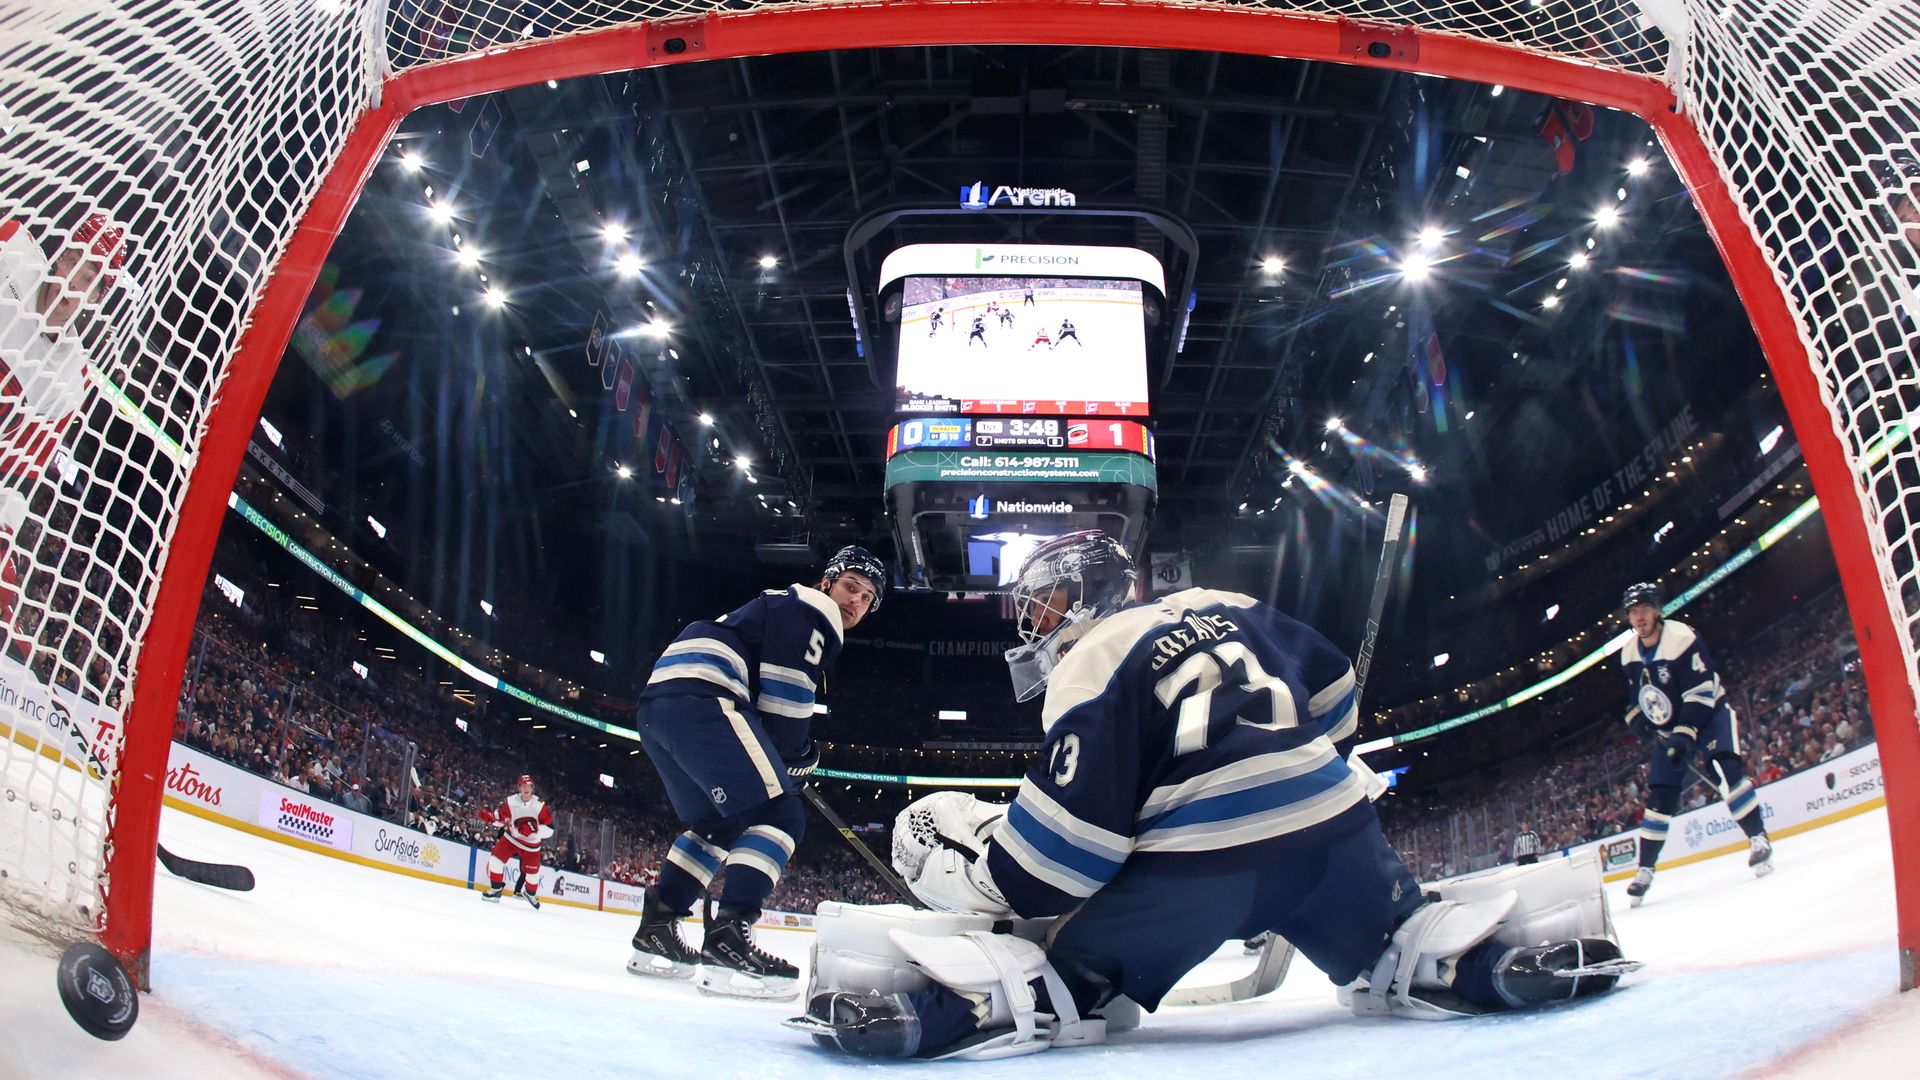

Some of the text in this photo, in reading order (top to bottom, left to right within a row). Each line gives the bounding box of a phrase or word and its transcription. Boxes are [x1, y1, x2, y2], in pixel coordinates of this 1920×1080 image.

[989, 186, 1076, 206] Arena
[1001, 255, 1079, 264] PRECISION
[904, 421, 923, 445] 0
[1108, 423, 1123, 446] 1
[940, 468, 1099, 478] precisionconstructionsystems.com
[960, 456, 1079, 468] Call: 614-987-5111
[1547, 496, 1593, 542] HOME
[1592, 479, 1615, 511] OF
[1615, 456, 1646, 494] THE
[1664, 404, 1699, 450] LINE
[997, 501, 1073, 513] Nationwide
[245, 507, 356, 595] PRECISION CONSTRUCTION SYSTEMS
[804, 628, 825, 666] 5
[1691, 652, 1707, 673] 4
[505, 683, 599, 728] PRECISION CONSTRUCTION SYSTEMS
[1153, 641, 1299, 758] 73
[827, 770, 872, 780] CONSTRUCTION
[1806, 797, 1825, 812] PUT
[1827, 779, 1875, 804] HACKERS
[280, 797, 334, 827] SealMaster
[375, 828, 419, 858] Surfside
[1610, 841, 1634, 857] APEX
[575, 885, 589, 894] PIZZA
[718, 942, 756, 972] CCM
